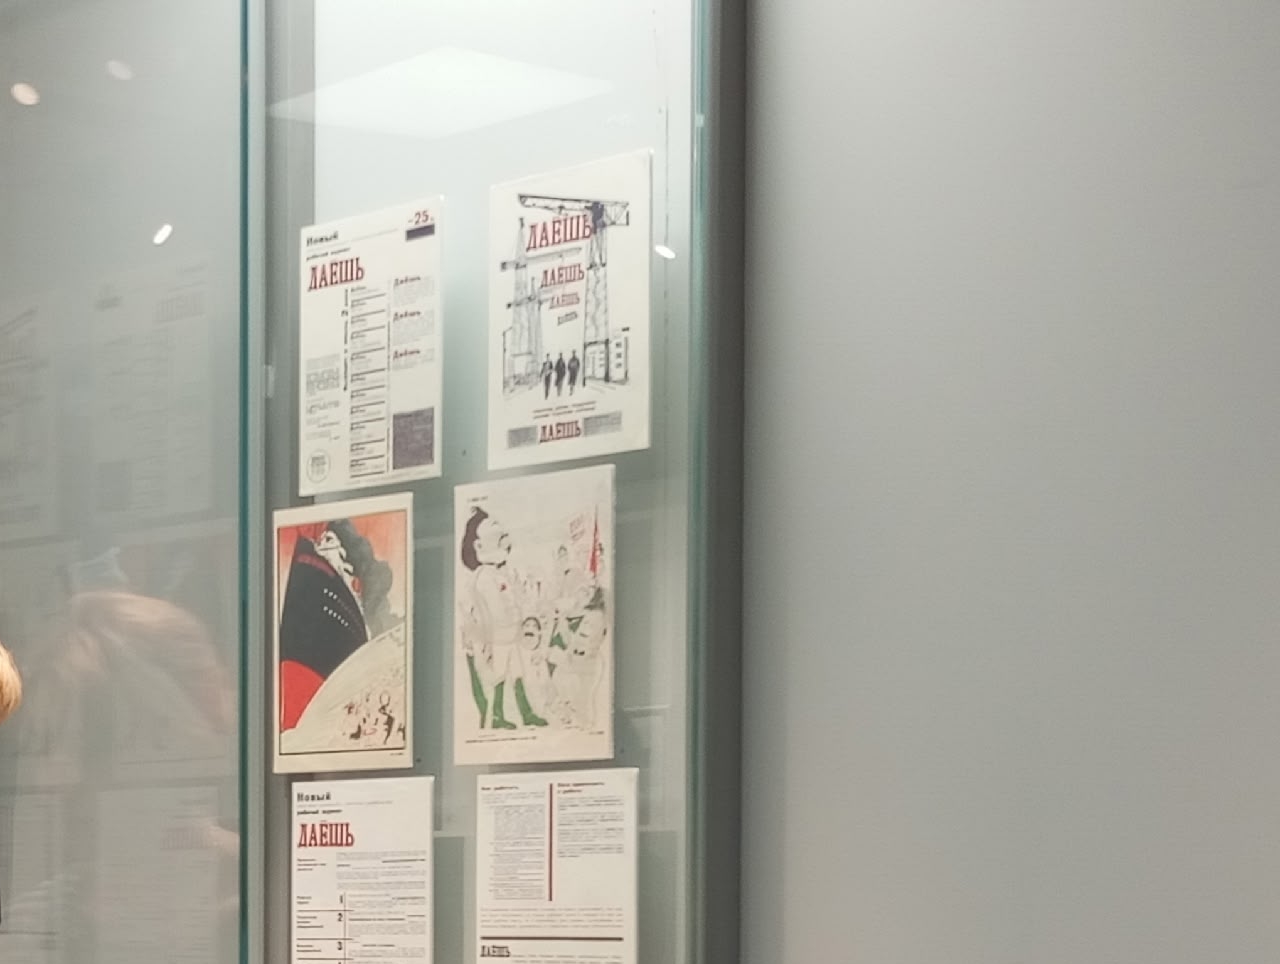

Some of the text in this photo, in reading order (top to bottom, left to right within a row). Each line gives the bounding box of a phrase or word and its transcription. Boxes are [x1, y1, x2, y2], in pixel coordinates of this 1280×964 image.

[306, 231, 339, 247] Новый
[297, 792, 331, 802] Новый
[337, 913, 343, 922] 2
[337, 941, 343, 951] 3
